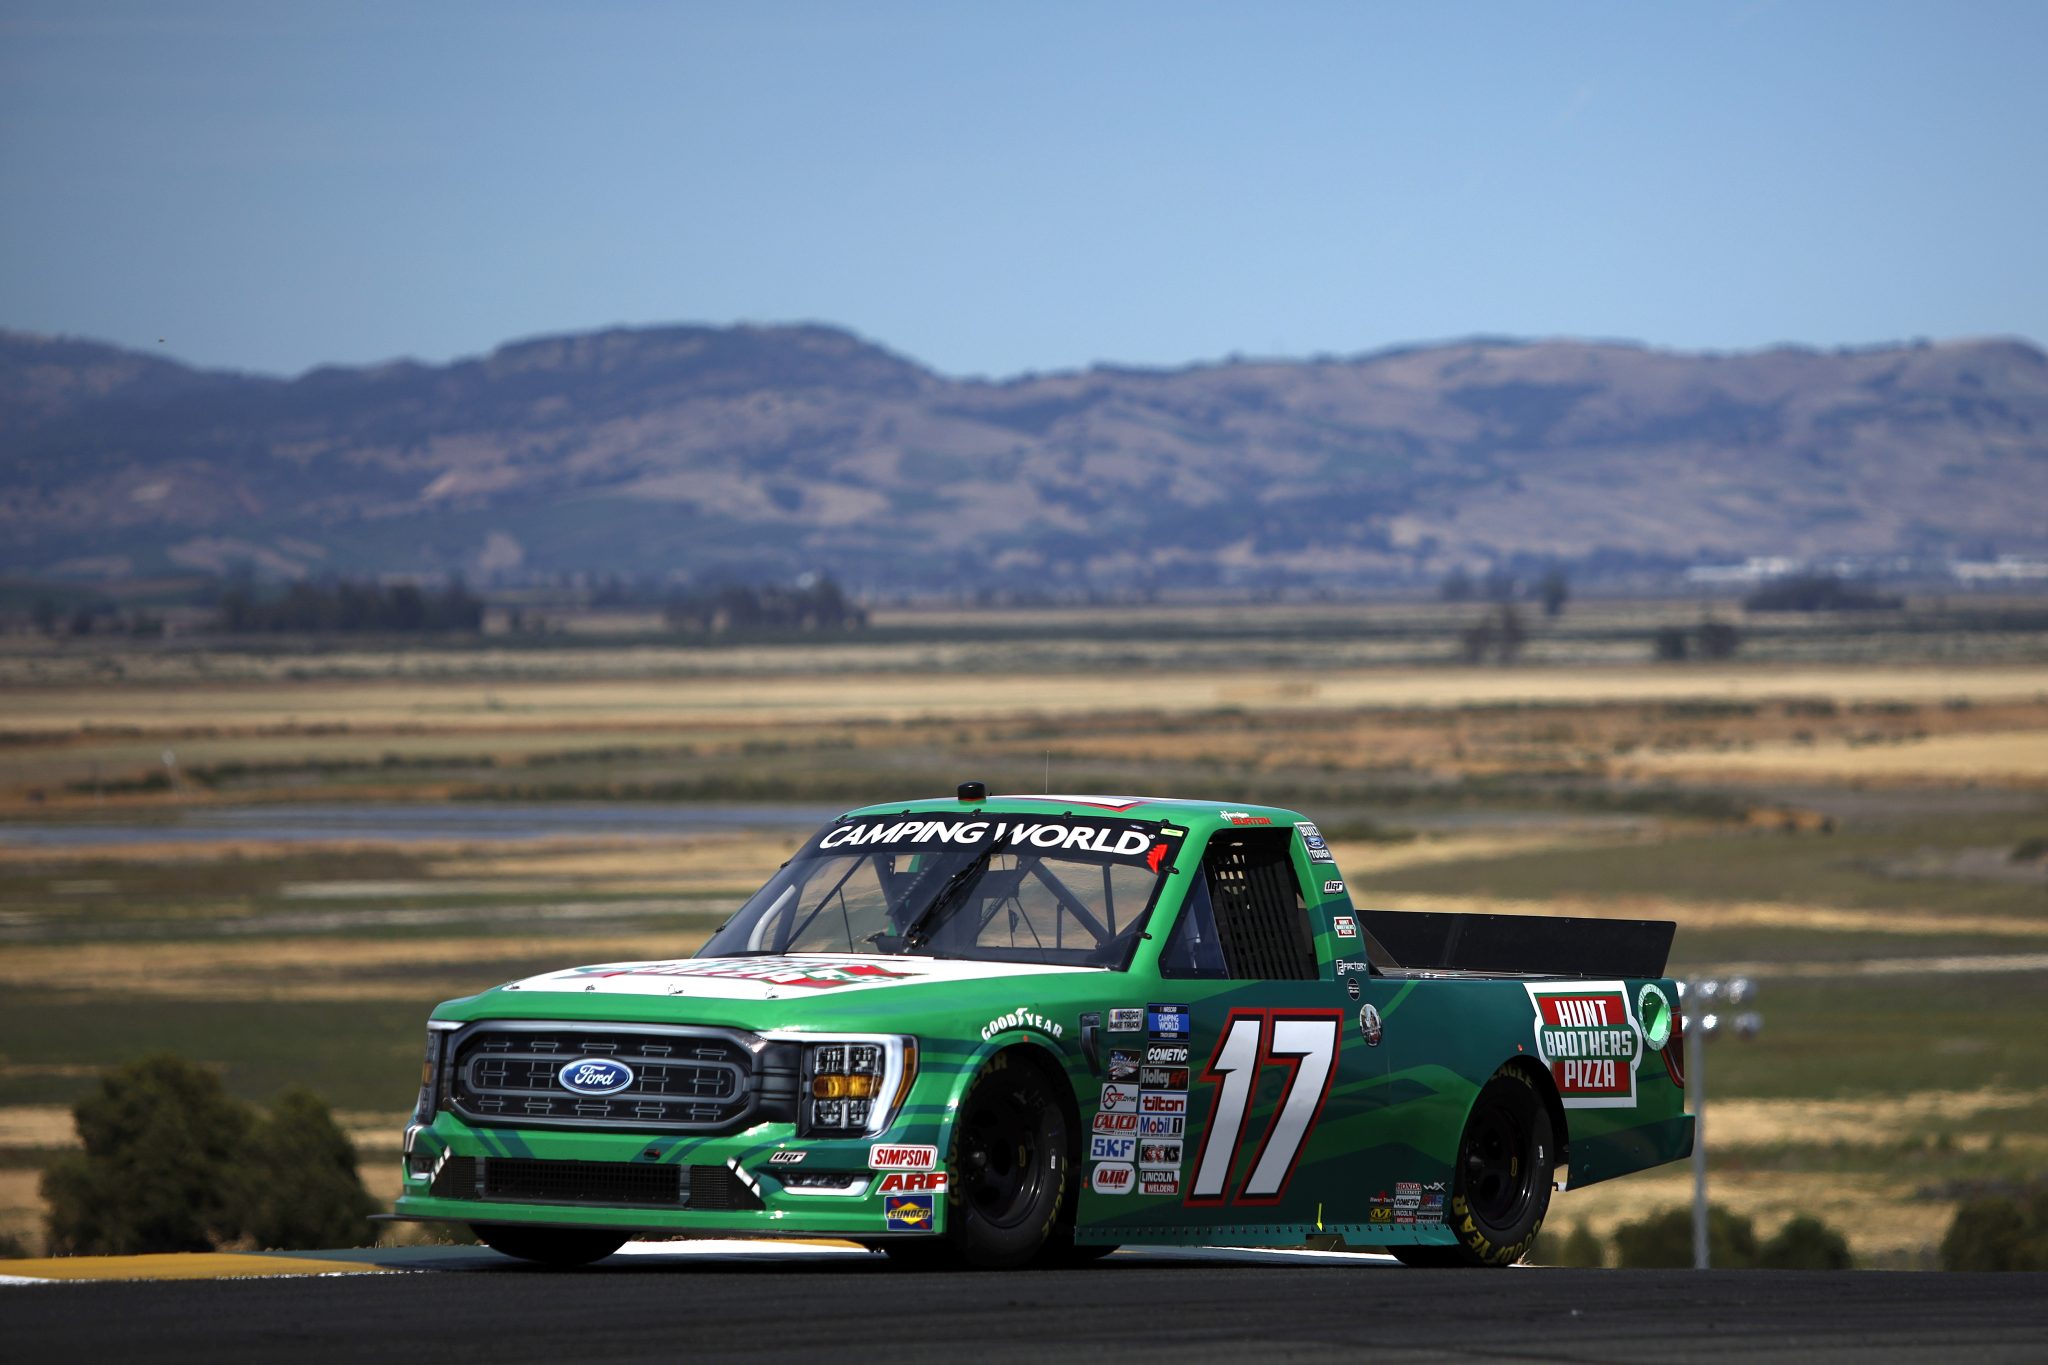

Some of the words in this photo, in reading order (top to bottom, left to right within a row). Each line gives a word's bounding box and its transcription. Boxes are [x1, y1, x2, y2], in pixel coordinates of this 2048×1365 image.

[1232, 817, 1272, 825] BURTON
[820, 821, 988, 849] CAMPING
[993, 823, 1149, 855] WORLD
[1300, 826, 1319, 836] BUILT
[1310, 849, 1330, 858] TOUGH
[1120, 1011, 1140, 1020] NASCAR
[1158, 1014, 1179, 1022] CAMPING
[1555, 1000, 1607, 1027] HUNT
[981, 1008, 1063, 1040] GOODYEAR
[1110, 1021, 1121, 1029] RACE
[1123, 1021, 1140, 1029] TRUCK
[1159, 1022, 1180, 1031] WORLD
[1543, 1030, 1633, 1056] BROTHERS
[1147, 1048, 1188, 1061] COMETIC
[574, 1064, 616, 1086] Ford
[1142, 1068, 1170, 1088] Holley
[1564, 1059, 1616, 1088] PIZZA
[1143, 1095, 1184, 1112] tilton
[1188, 1014, 1340, 1202] 17
[1094, 1114, 1137, 1130] CALICO
[1140, 1116, 1169, 1133] Mobil
[1092, 1139, 1134, 1157] SKF
[875, 1149, 931, 1166] SIMPSON
[879, 1173, 947, 1191] ARP
[1142, 1172, 1173, 1182] LINCOLN
[1147, 1184, 1175, 1193] WELDERS
[890, 1209, 931, 1219] SUNOCO
